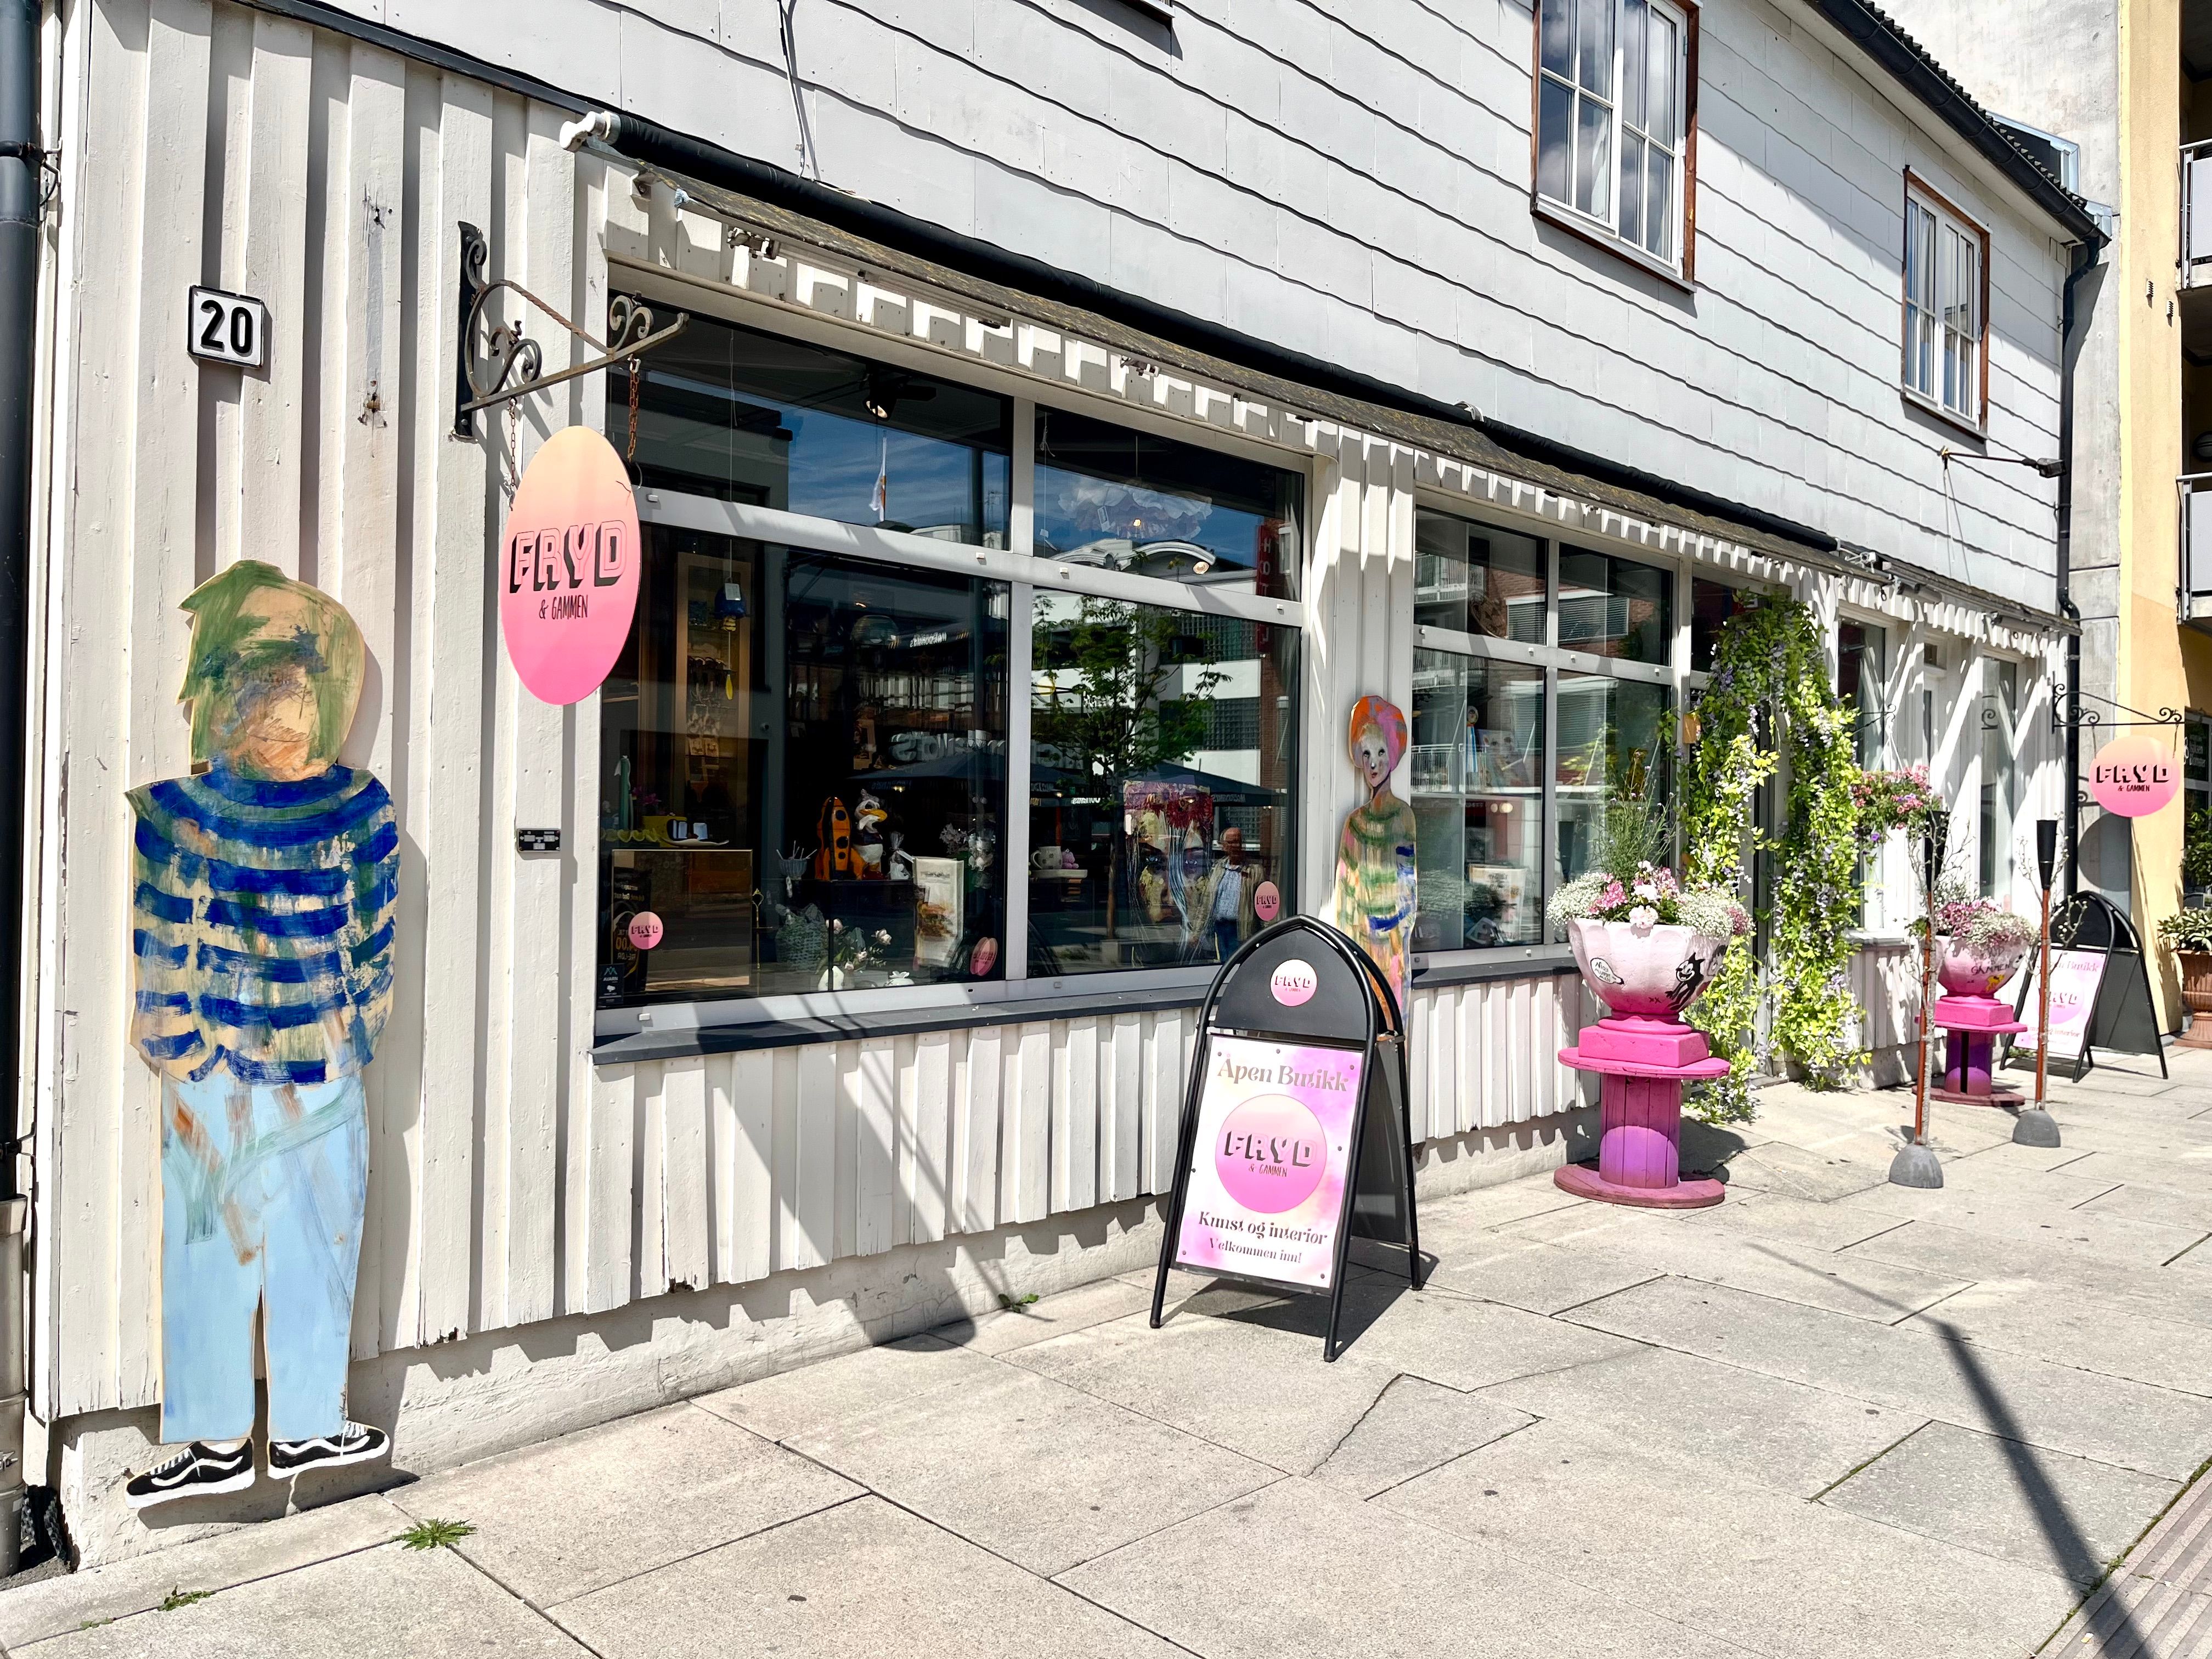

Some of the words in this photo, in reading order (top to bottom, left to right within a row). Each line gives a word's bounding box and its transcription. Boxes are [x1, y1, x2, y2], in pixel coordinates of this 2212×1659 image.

[201, 300, 253, 357] 20
[509, 520, 627, 594] FRYD
[539, 599, 549, 619] &
[552, 594, 588, 619] GAMMEN
[2096, 764, 2172, 783] FRYD
[1275, 975, 1312, 988] FRYD
[1217, 1053, 1272, 1084] Åpen
[1277, 1065, 1349, 1092] Butikk
[1224, 1130, 1317, 1167] FRYD
[1249, 1164, 1256, 1172] &
[1259, 1164, 1288, 1177] GAMMEN
[1199, 1211, 1244, 1232] Kunst
[1248, 1222, 1266, 1239] og
[1269, 1222, 1328, 1244] interior
[1210, 1237, 1277, 1260] Velkommen
[1279, 1249, 1302, 1263] inn!
